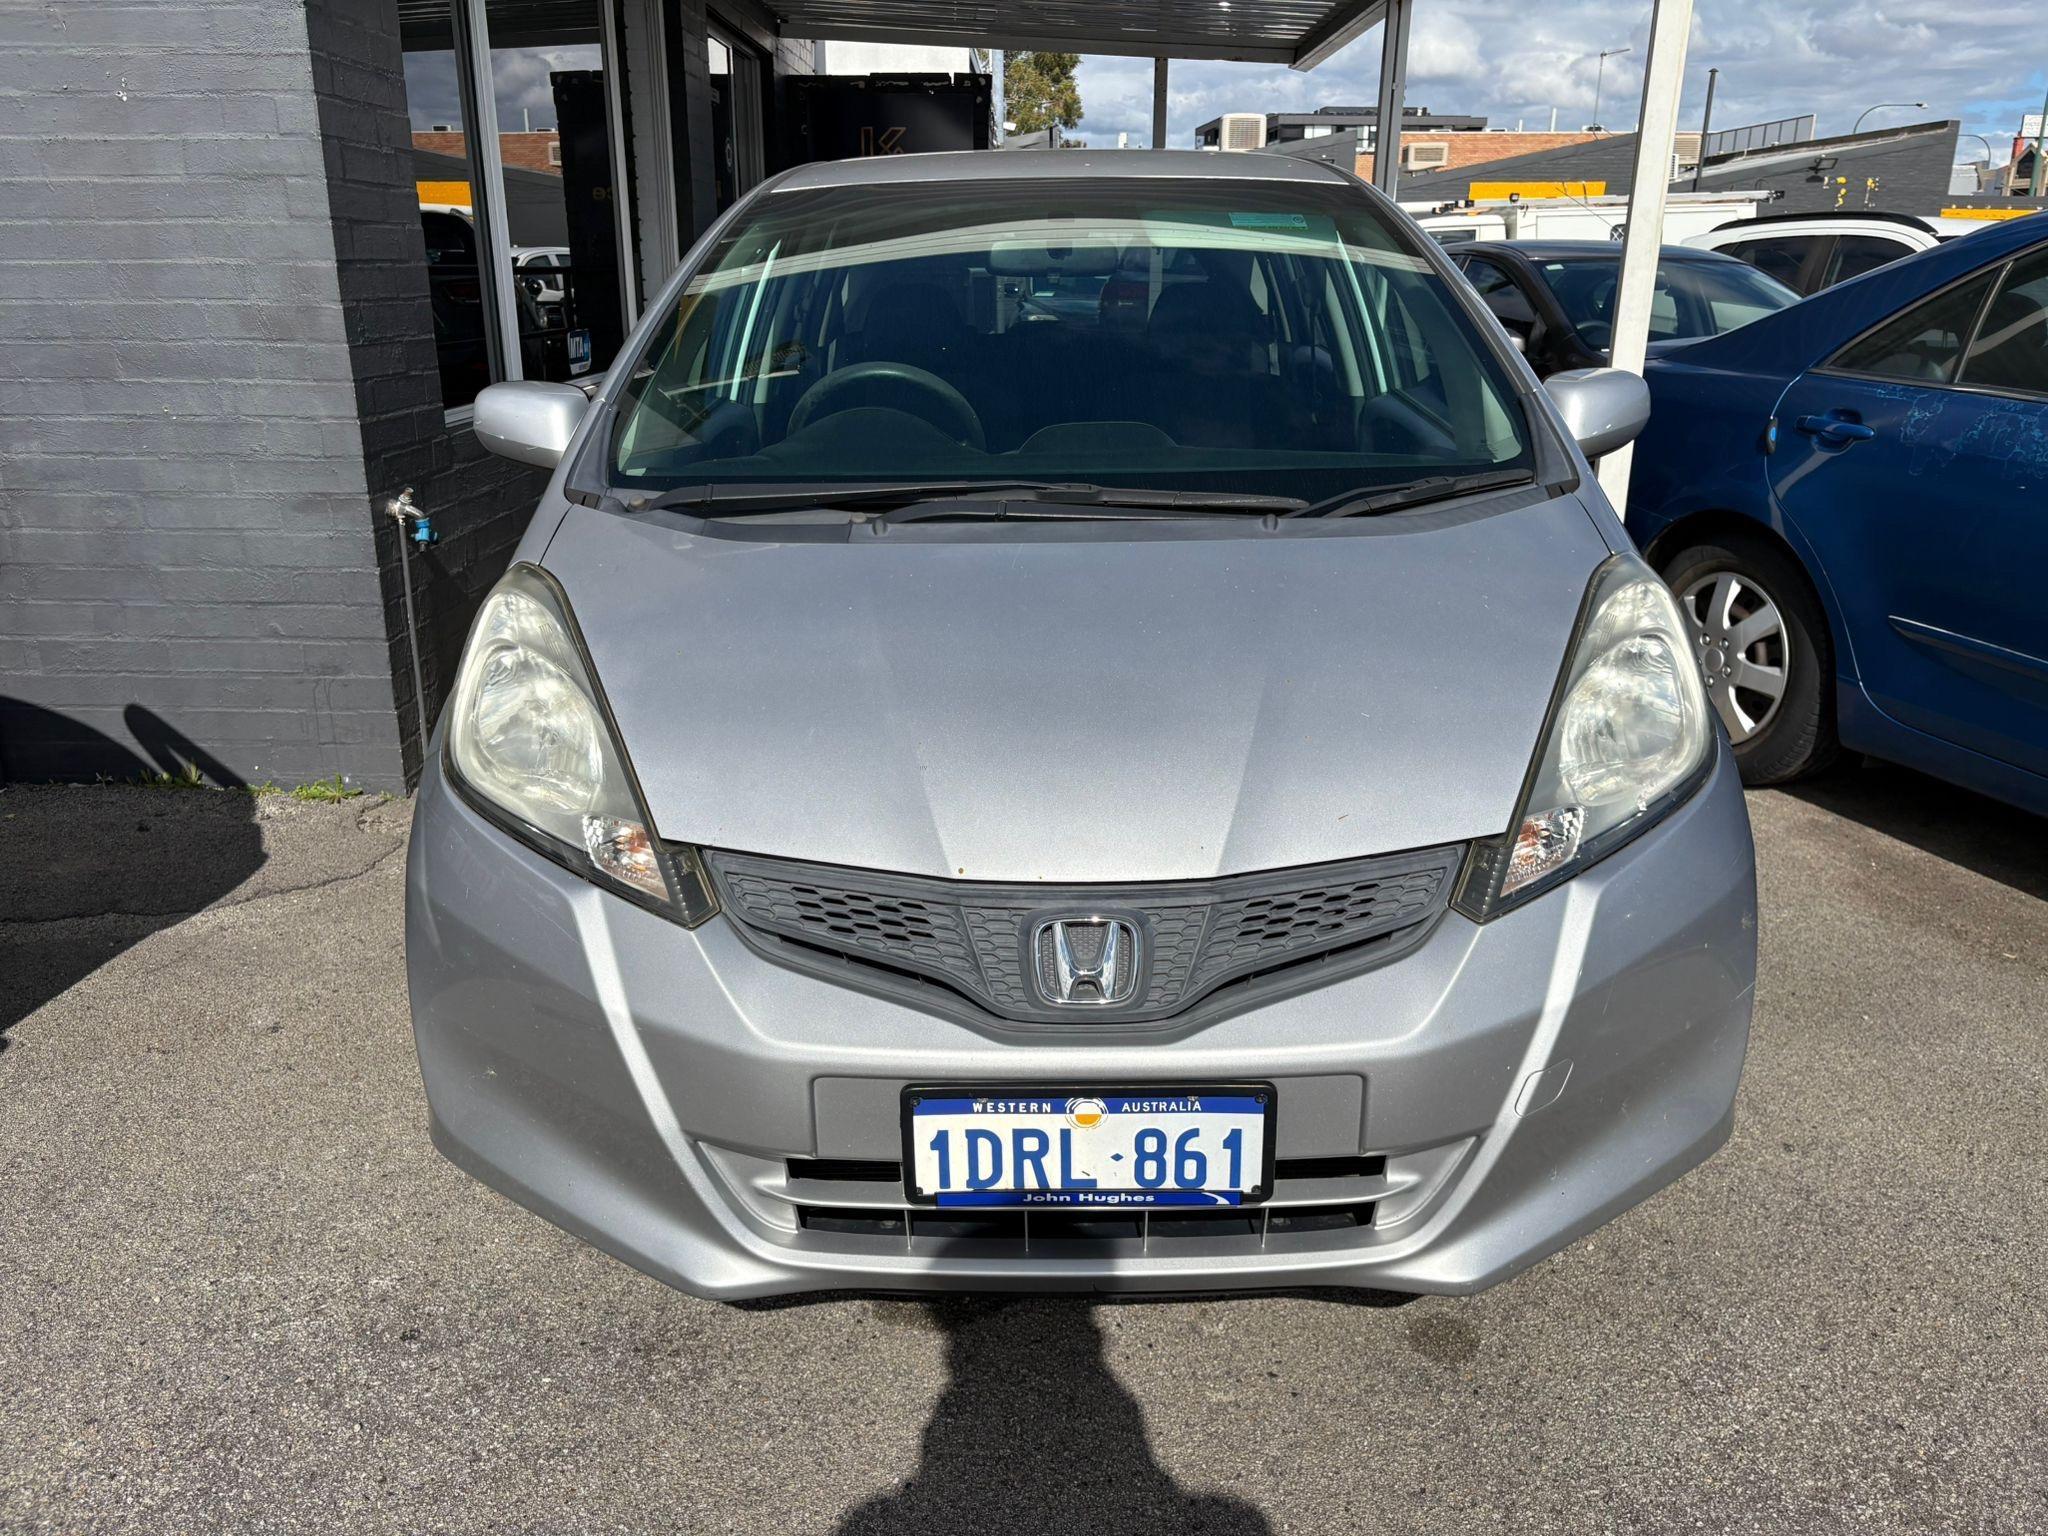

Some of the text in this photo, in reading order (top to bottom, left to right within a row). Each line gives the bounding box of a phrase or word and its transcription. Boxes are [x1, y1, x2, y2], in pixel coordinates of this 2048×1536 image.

[972, 1099, 1203, 1114] WESTERN AUSTRALIA
[1023, 1192, 1156, 1205] John Hughes
